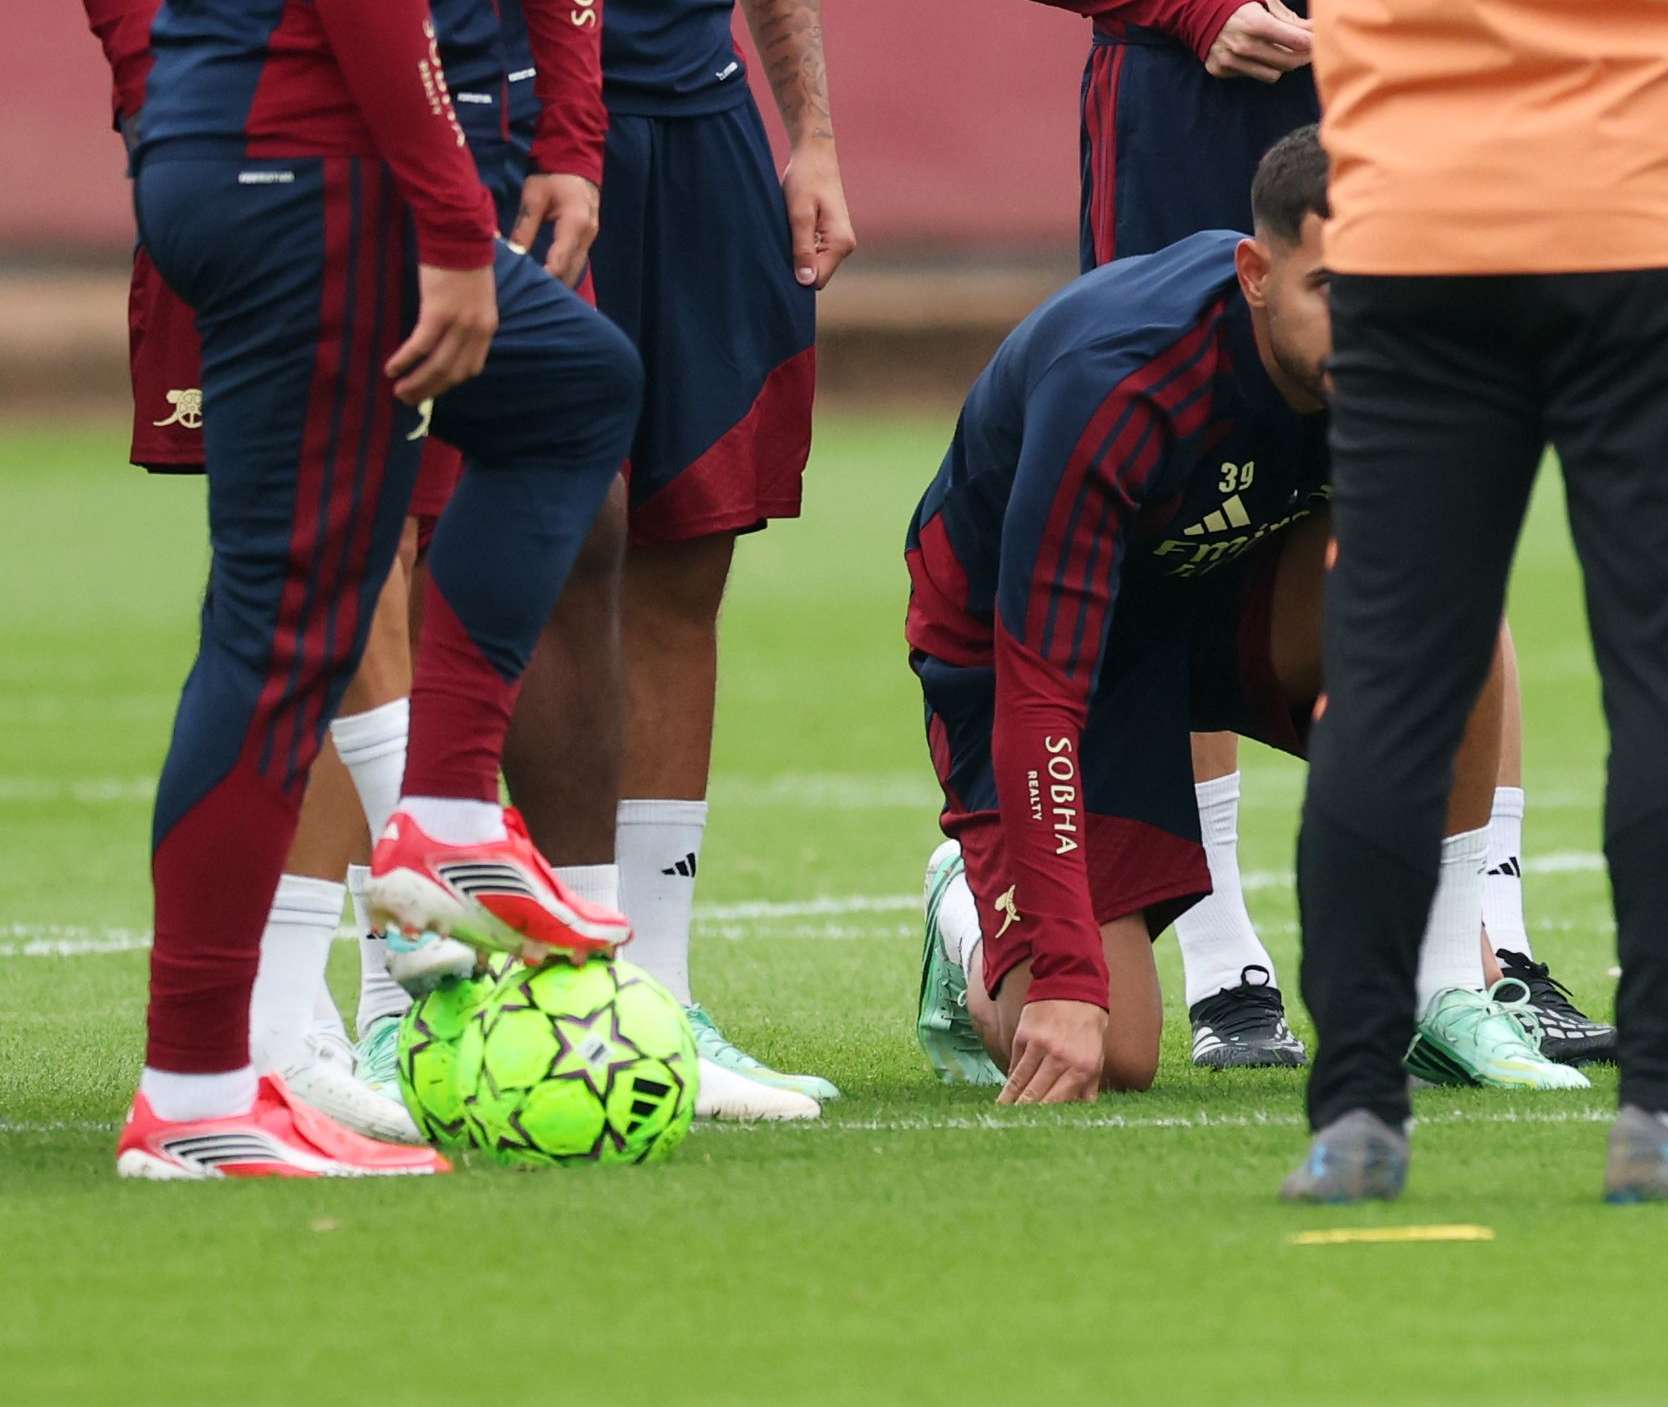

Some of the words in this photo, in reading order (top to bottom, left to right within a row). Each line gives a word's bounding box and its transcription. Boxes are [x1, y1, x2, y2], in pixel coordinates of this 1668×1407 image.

[1218, 461, 1255, 492] 39
[1027, 770, 1042, 821] REALTY
[1045, 736, 1078, 855] SOBHA
